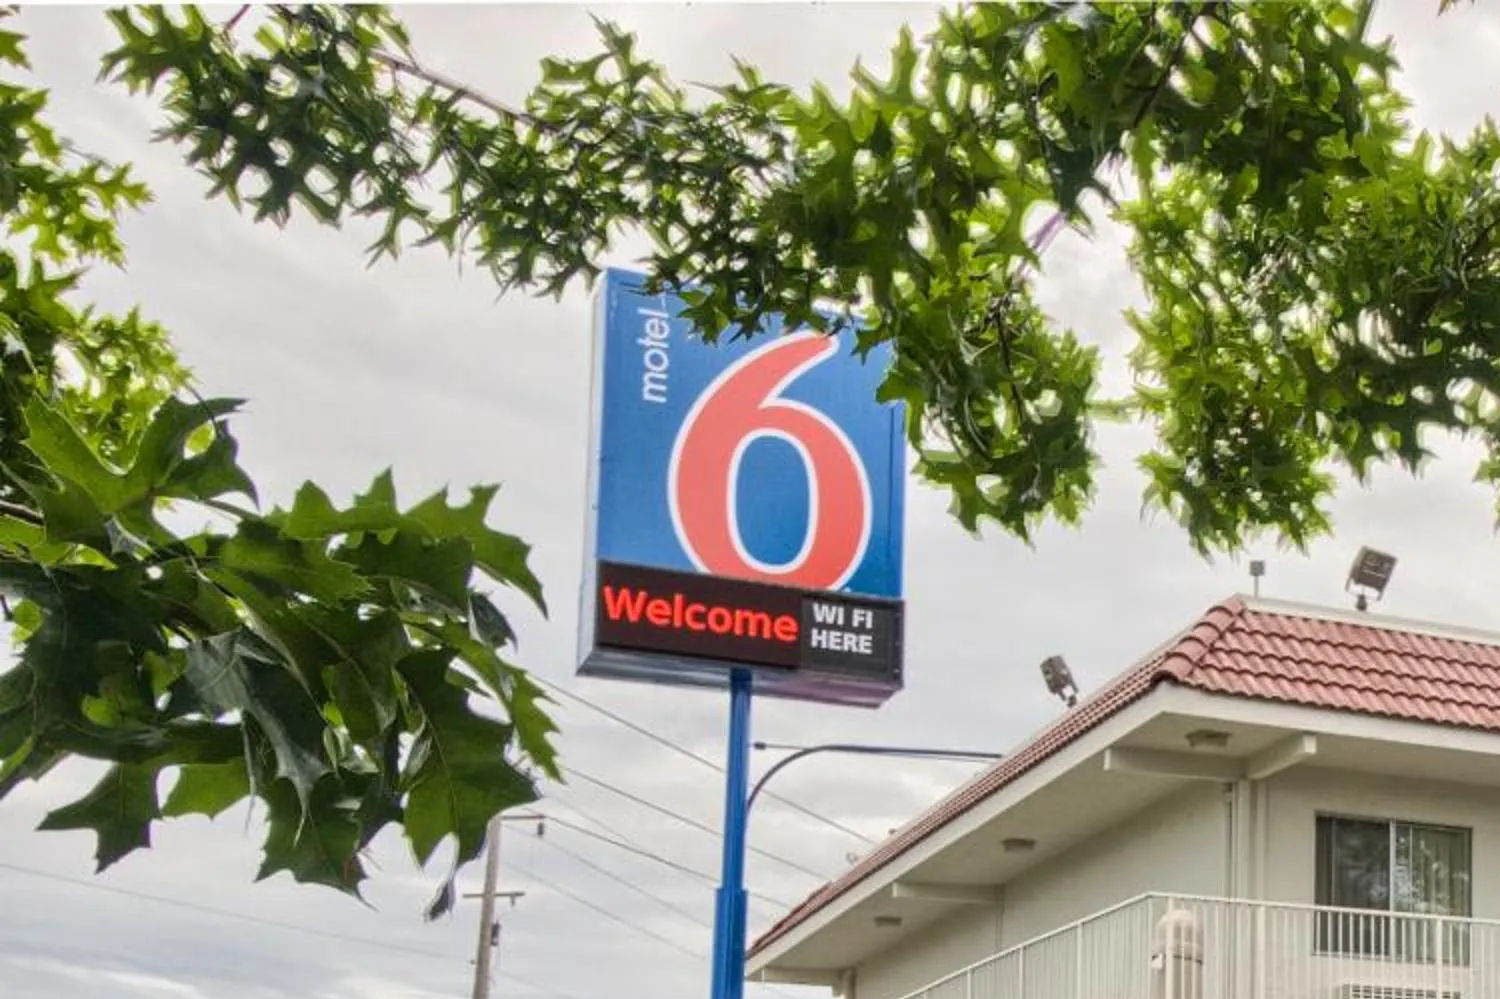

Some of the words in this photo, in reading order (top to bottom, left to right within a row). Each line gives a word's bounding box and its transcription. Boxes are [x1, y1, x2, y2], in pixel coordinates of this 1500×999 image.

[637, 306, 671, 403] motel
[668, 330, 872, 592] 6
[603, 585, 799, 641] Welcome
[813, 603, 844, 626] WI
[852, 607, 873, 629] FI
[810, 628, 873, 655] HERE
